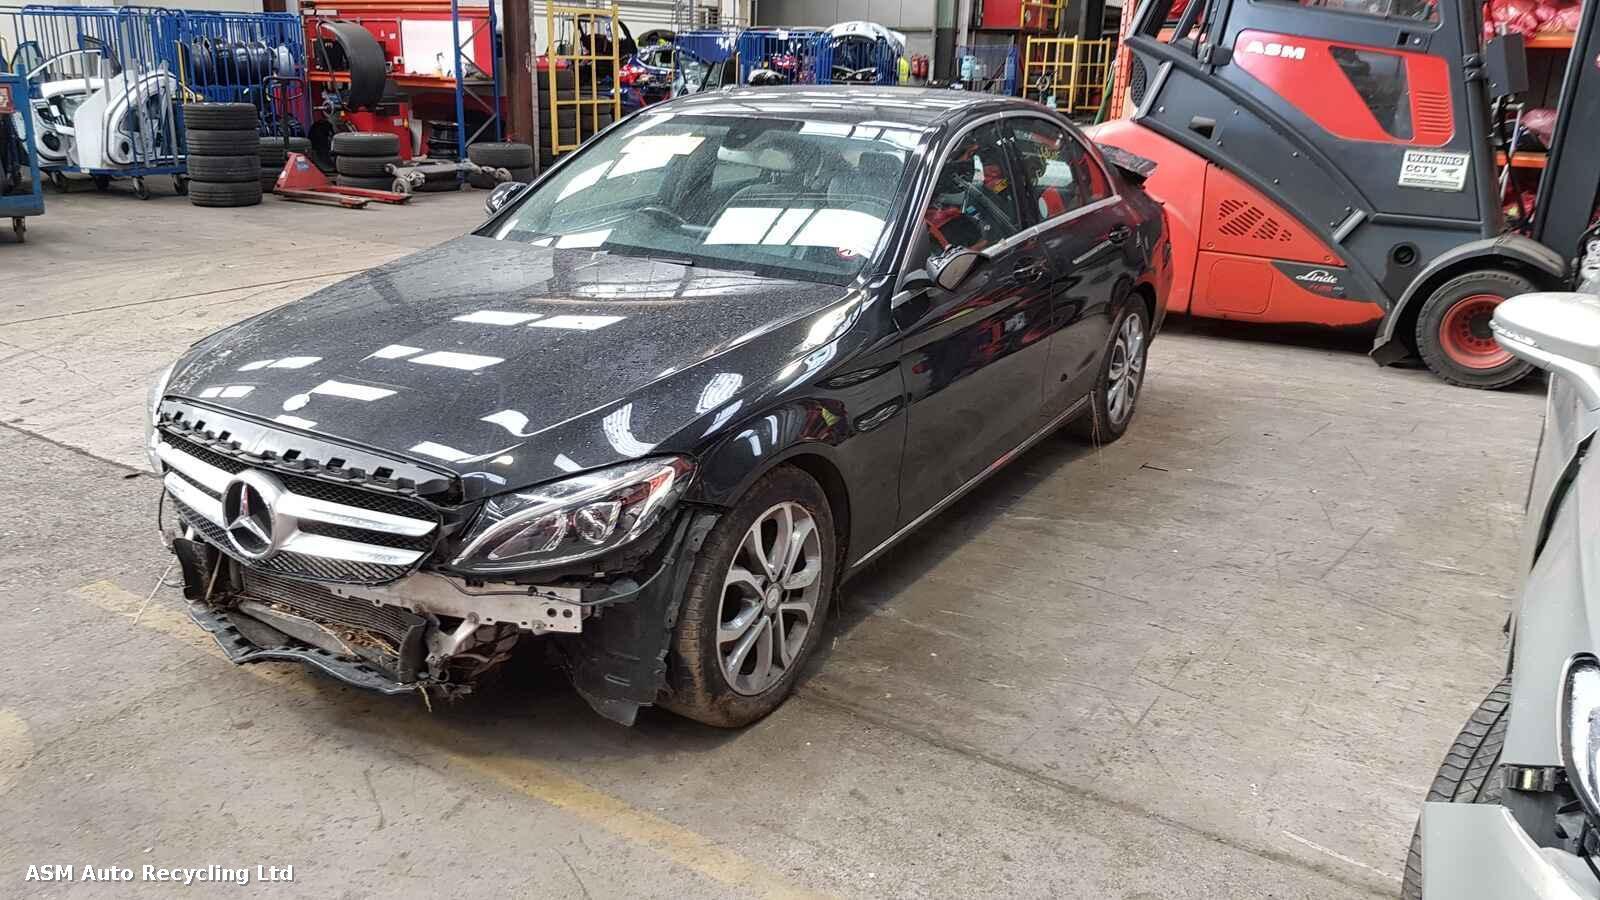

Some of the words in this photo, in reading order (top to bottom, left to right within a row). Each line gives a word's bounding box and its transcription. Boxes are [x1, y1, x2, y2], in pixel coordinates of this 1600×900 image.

[1246, 40, 1306, 60] ASM
[1409, 154, 1464, 166] WARNING
[1406, 164, 1437, 173] CCTV
[1296, 269, 1338, 284] Linde
